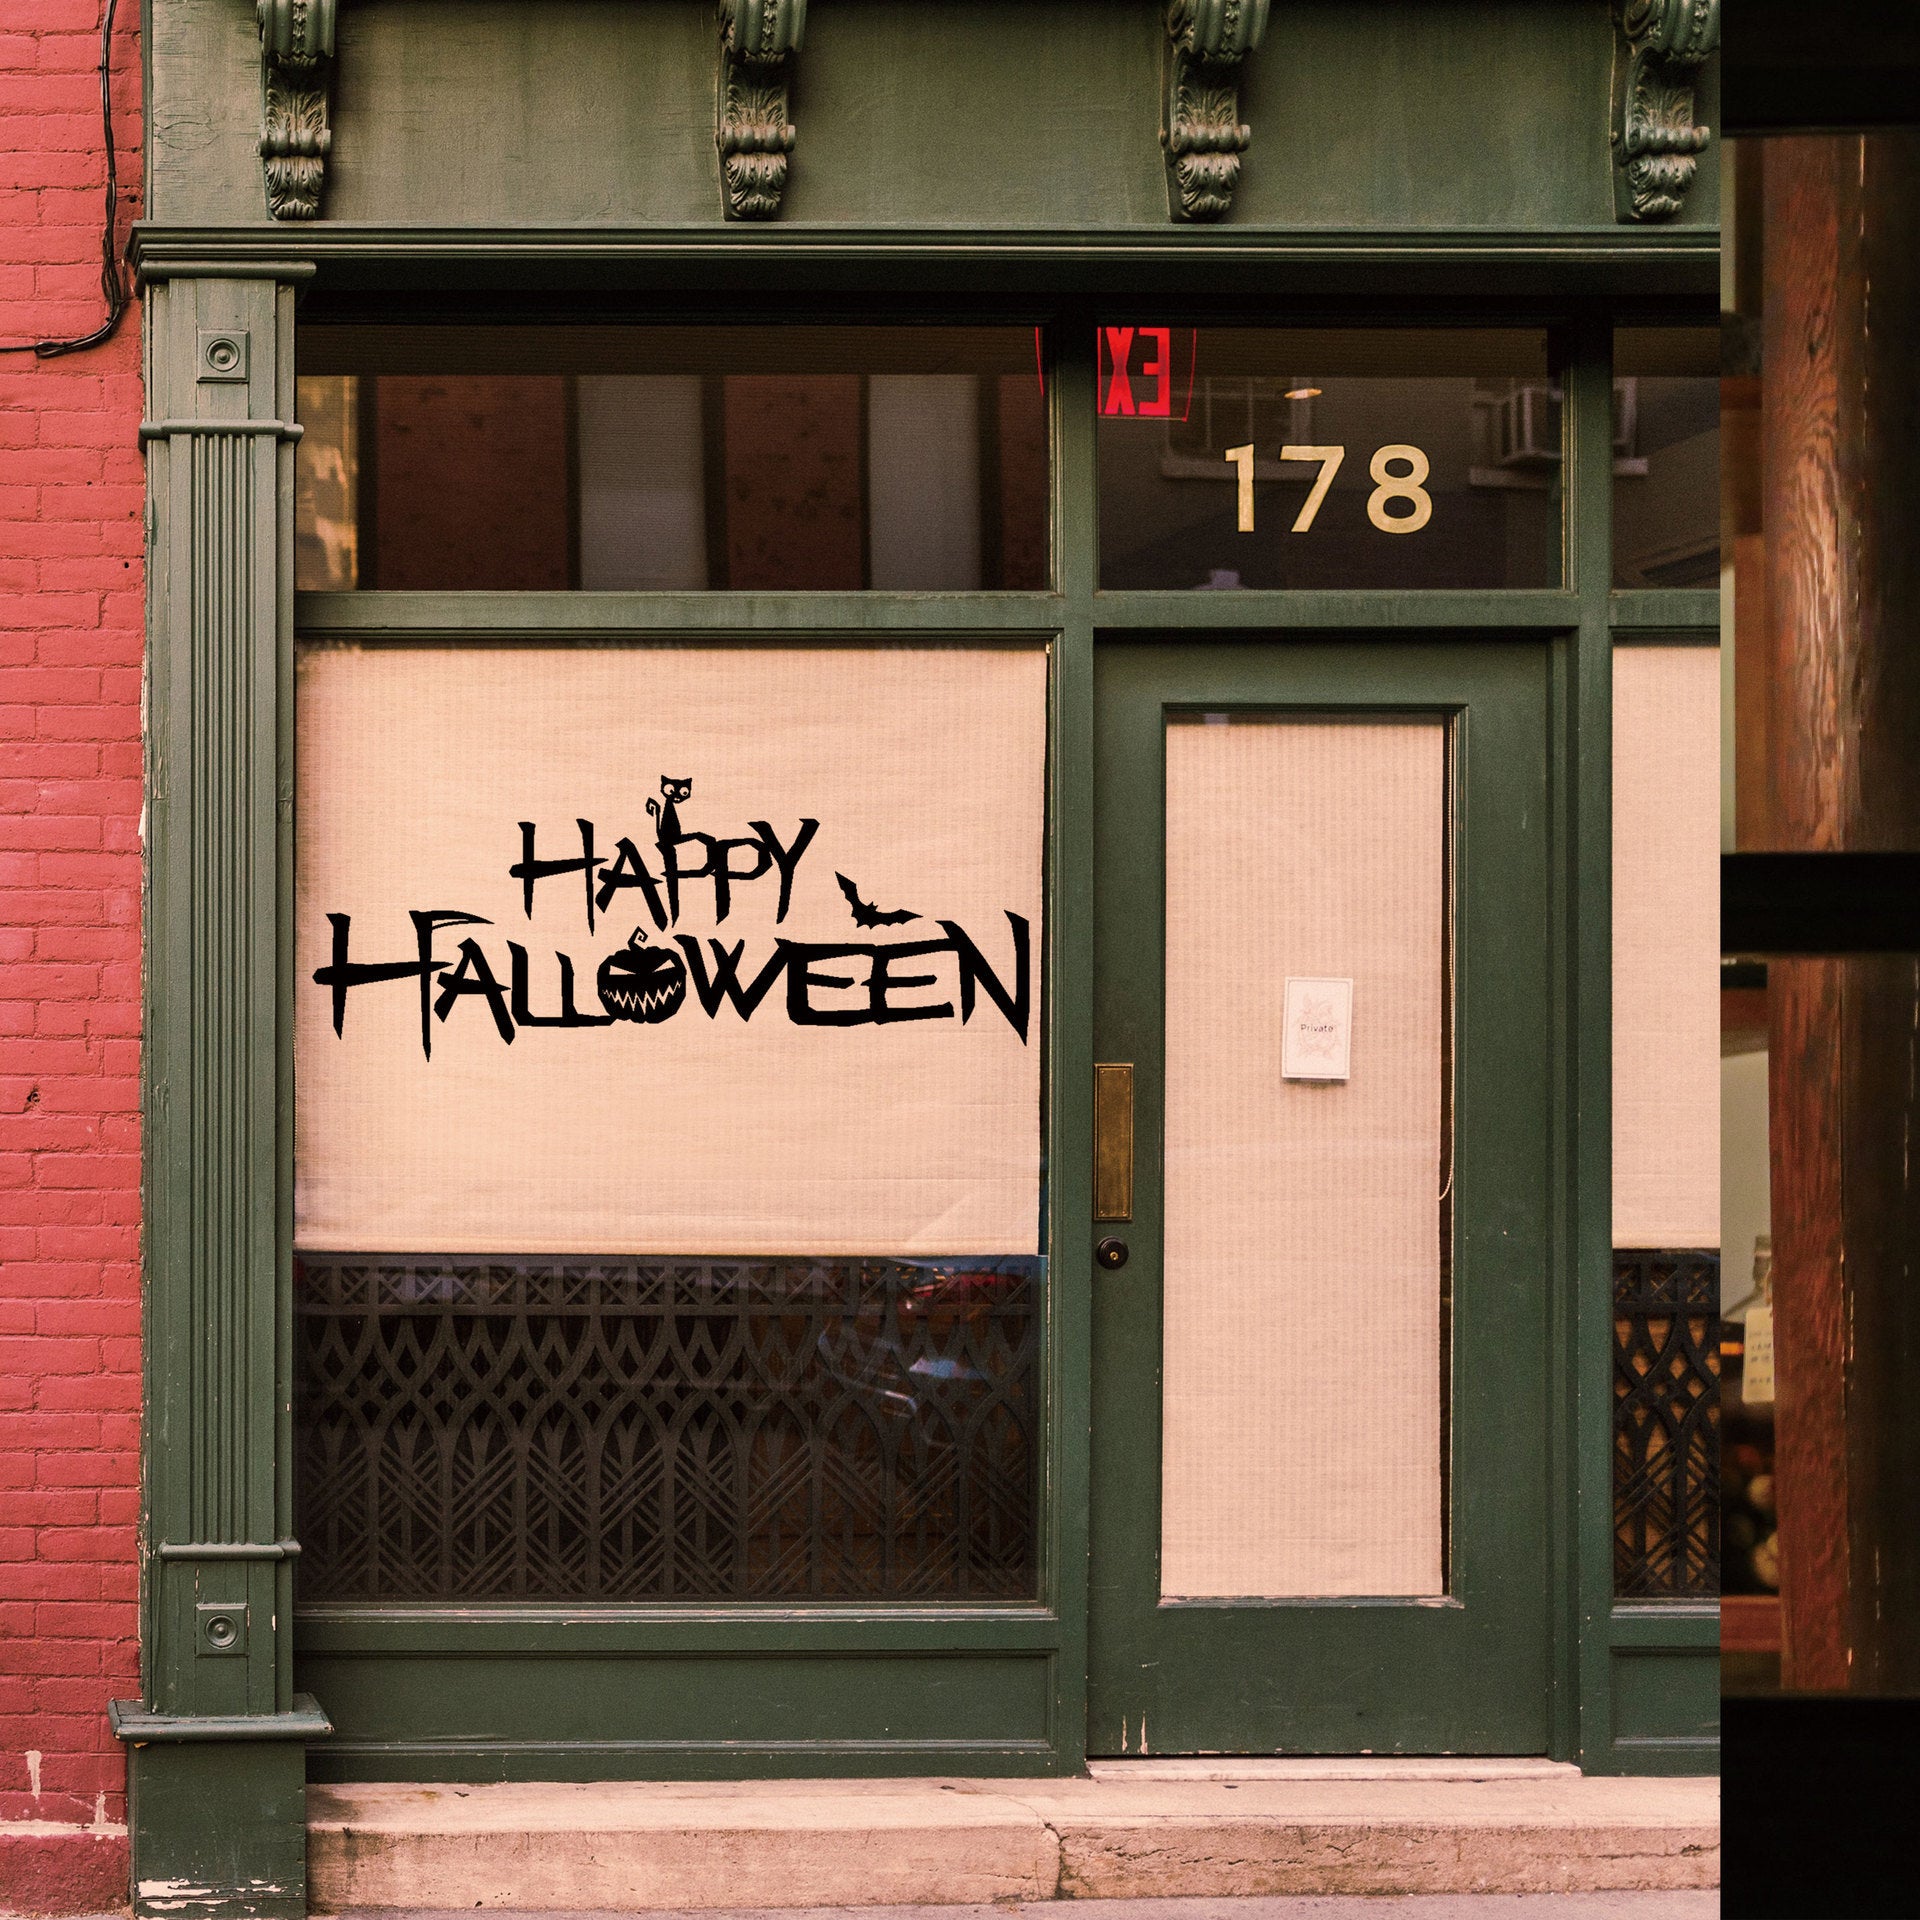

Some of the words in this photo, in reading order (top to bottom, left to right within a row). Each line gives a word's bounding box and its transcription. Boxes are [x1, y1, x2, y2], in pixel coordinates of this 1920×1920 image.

[1225, 443, 1433, 534] 178
[508, 818, 820, 937] HAPPY
[312, 910, 1031, 1063] HALLOWEEN
[1300, 1023, 1334, 1033] Private
